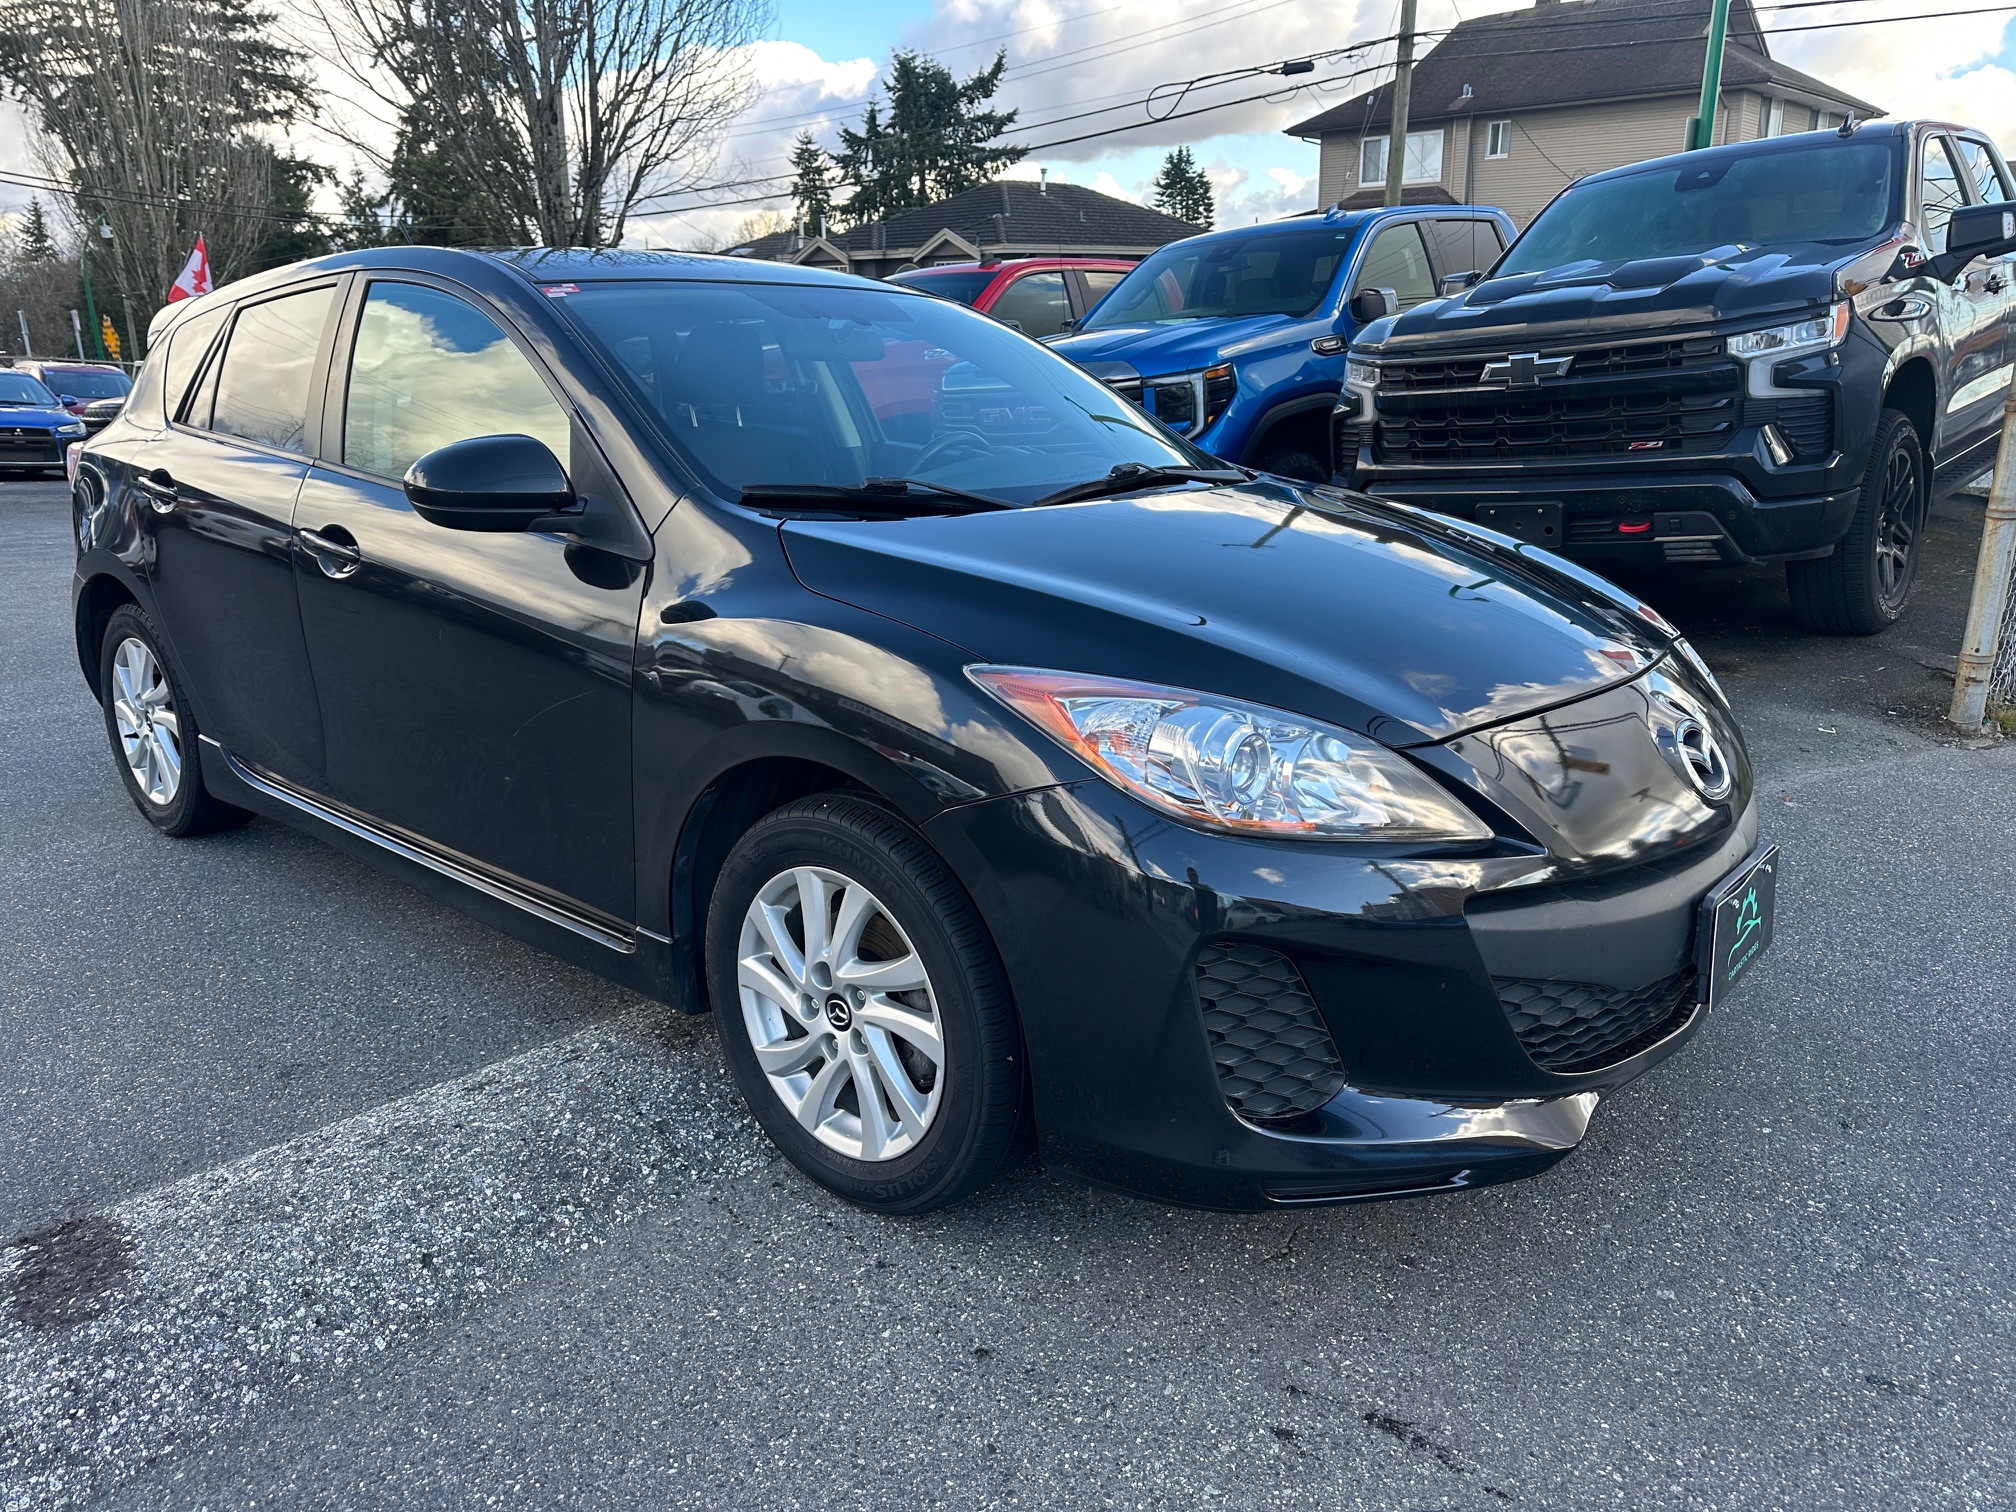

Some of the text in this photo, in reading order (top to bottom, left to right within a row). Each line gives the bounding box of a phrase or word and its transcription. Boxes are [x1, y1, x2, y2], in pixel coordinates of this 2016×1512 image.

[978, 405, 1051, 426] GMC
[821, 836, 903, 901] KUMHO
[875, 1158, 940, 1199] SOLUS
